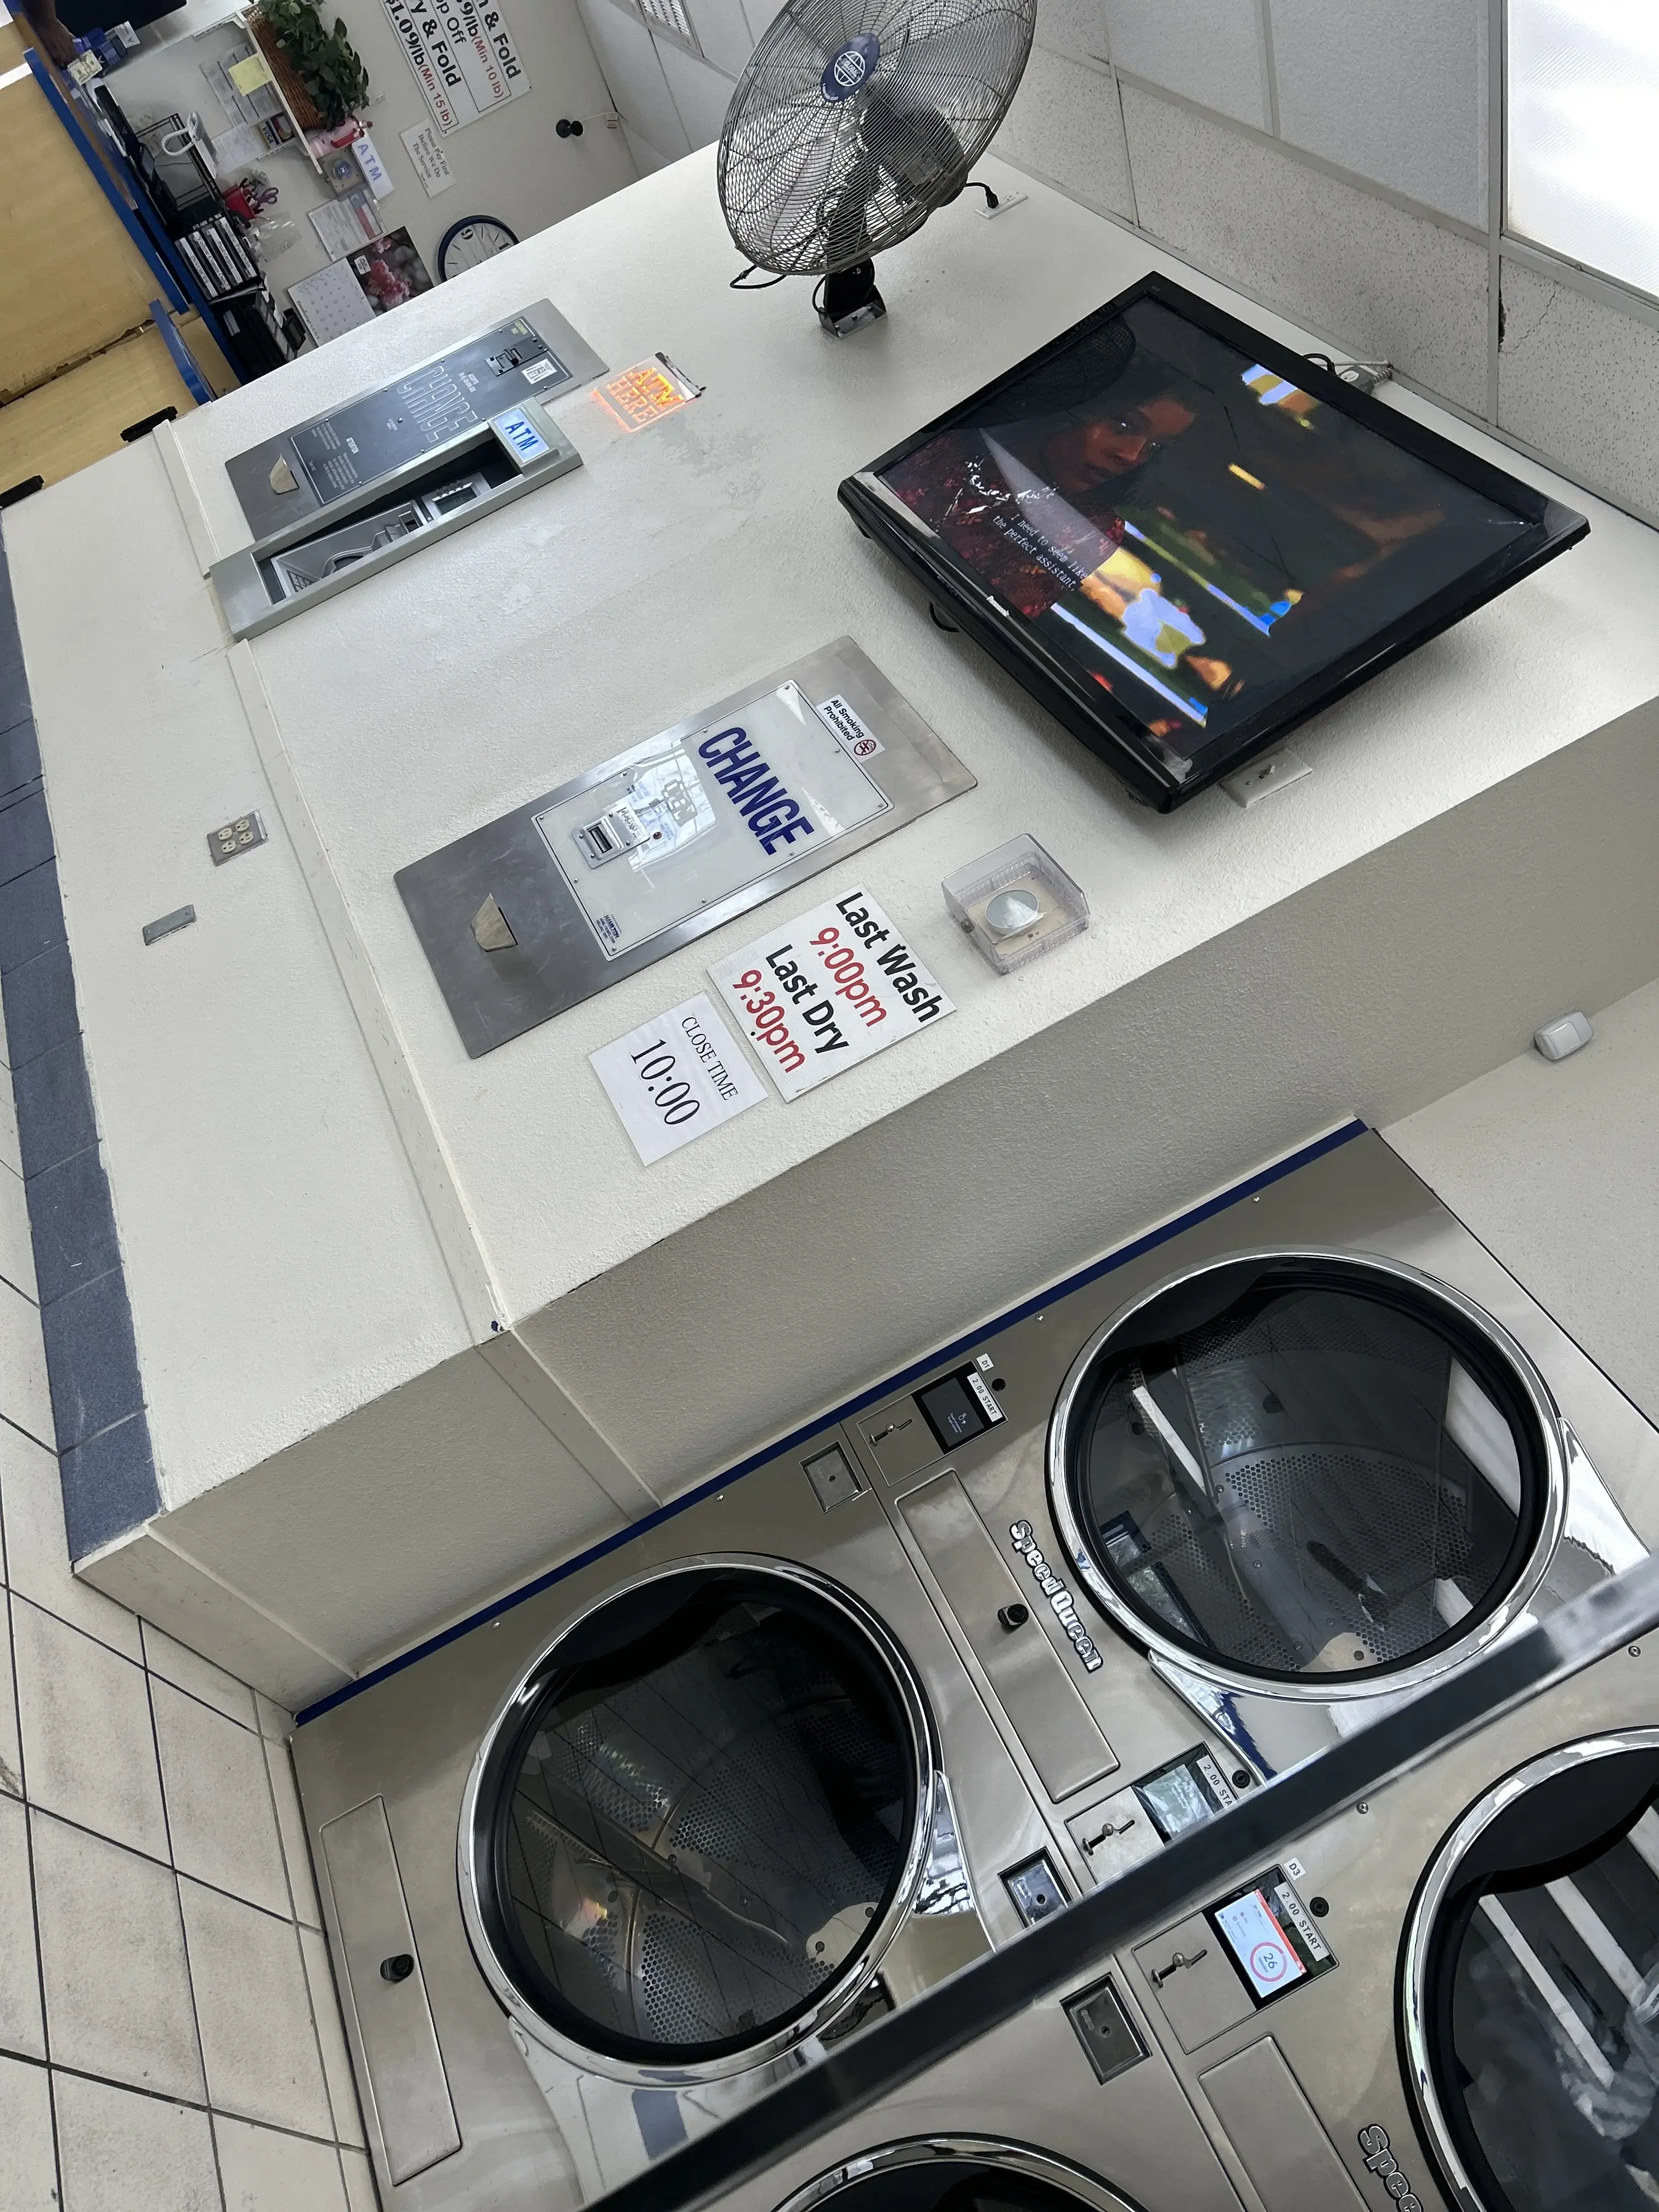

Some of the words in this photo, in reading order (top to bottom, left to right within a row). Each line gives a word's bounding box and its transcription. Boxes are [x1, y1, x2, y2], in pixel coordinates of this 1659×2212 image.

[447, 17, 466, 44] Off
[484, 11, 500, 32] &
[493, 32, 521, 78] Fold
[422, 19, 437, 39] &
[431, 41, 462, 87] Fold
[486, 65, 497, 81] 10
[492, 81, 504, 98] lb)
[433, 93, 445, 108] 15
[440, 109, 453, 126] lb)
[262, 126, 274, 143] VISA
[425, 127, 437, 148] Please
[434, 148, 443, 160] Pay
[440, 160, 449, 175] First
[357, 144, 382, 180] ATM
[418, 134, 430, 155] Before
[429, 156, 436, 167] We
[434, 167, 441, 178] Do
[419, 155, 431, 178] Service
[397, 365, 478, 443] CHANGE
[606, 375, 659, 424] HERE
[628, 366, 685, 410] ATM
[505, 421, 538, 451] ATM
[993, 515, 1007, 529] the
[1004, 528, 1037, 554] perfect
[1018, 520, 1039, 537] need
[1037, 535, 1049, 546] to
[1048, 546, 1068, 562] seem
[1068, 561, 1088, 579] like
[986, 595, 1009, 617] Panasonic
[823, 706, 855, 741] Prohibited
[831, 699, 843, 709] All
[839, 708, 865, 738] Smoking
[698, 727, 815, 856] CHANGE
[809, 927, 887, 1027] 9:00pm
[836, 891, 890, 950] Last
[877, 943, 943, 1023] Wash
[765, 944, 819, 1005] Last
[802, 999, 849, 1054] Dry
[732, 969, 805, 1073] 9:30pm
[682, 1017, 716, 1063] CLOSE
[707, 1060, 738, 1101] TIME
[631, 1039, 700, 1125] 10:00
[981, 1359, 990, 1368] D1
[983, 1396, 997, 1414] START
[1204, 1764, 1220, 1786] 2.00
[1289, 1863, 1301, 1876] D3
[1282, 1892, 1300, 1915] 2.00
[1299, 1920, 1322, 1950] START
[1263, 1953, 1278, 1969] 26
